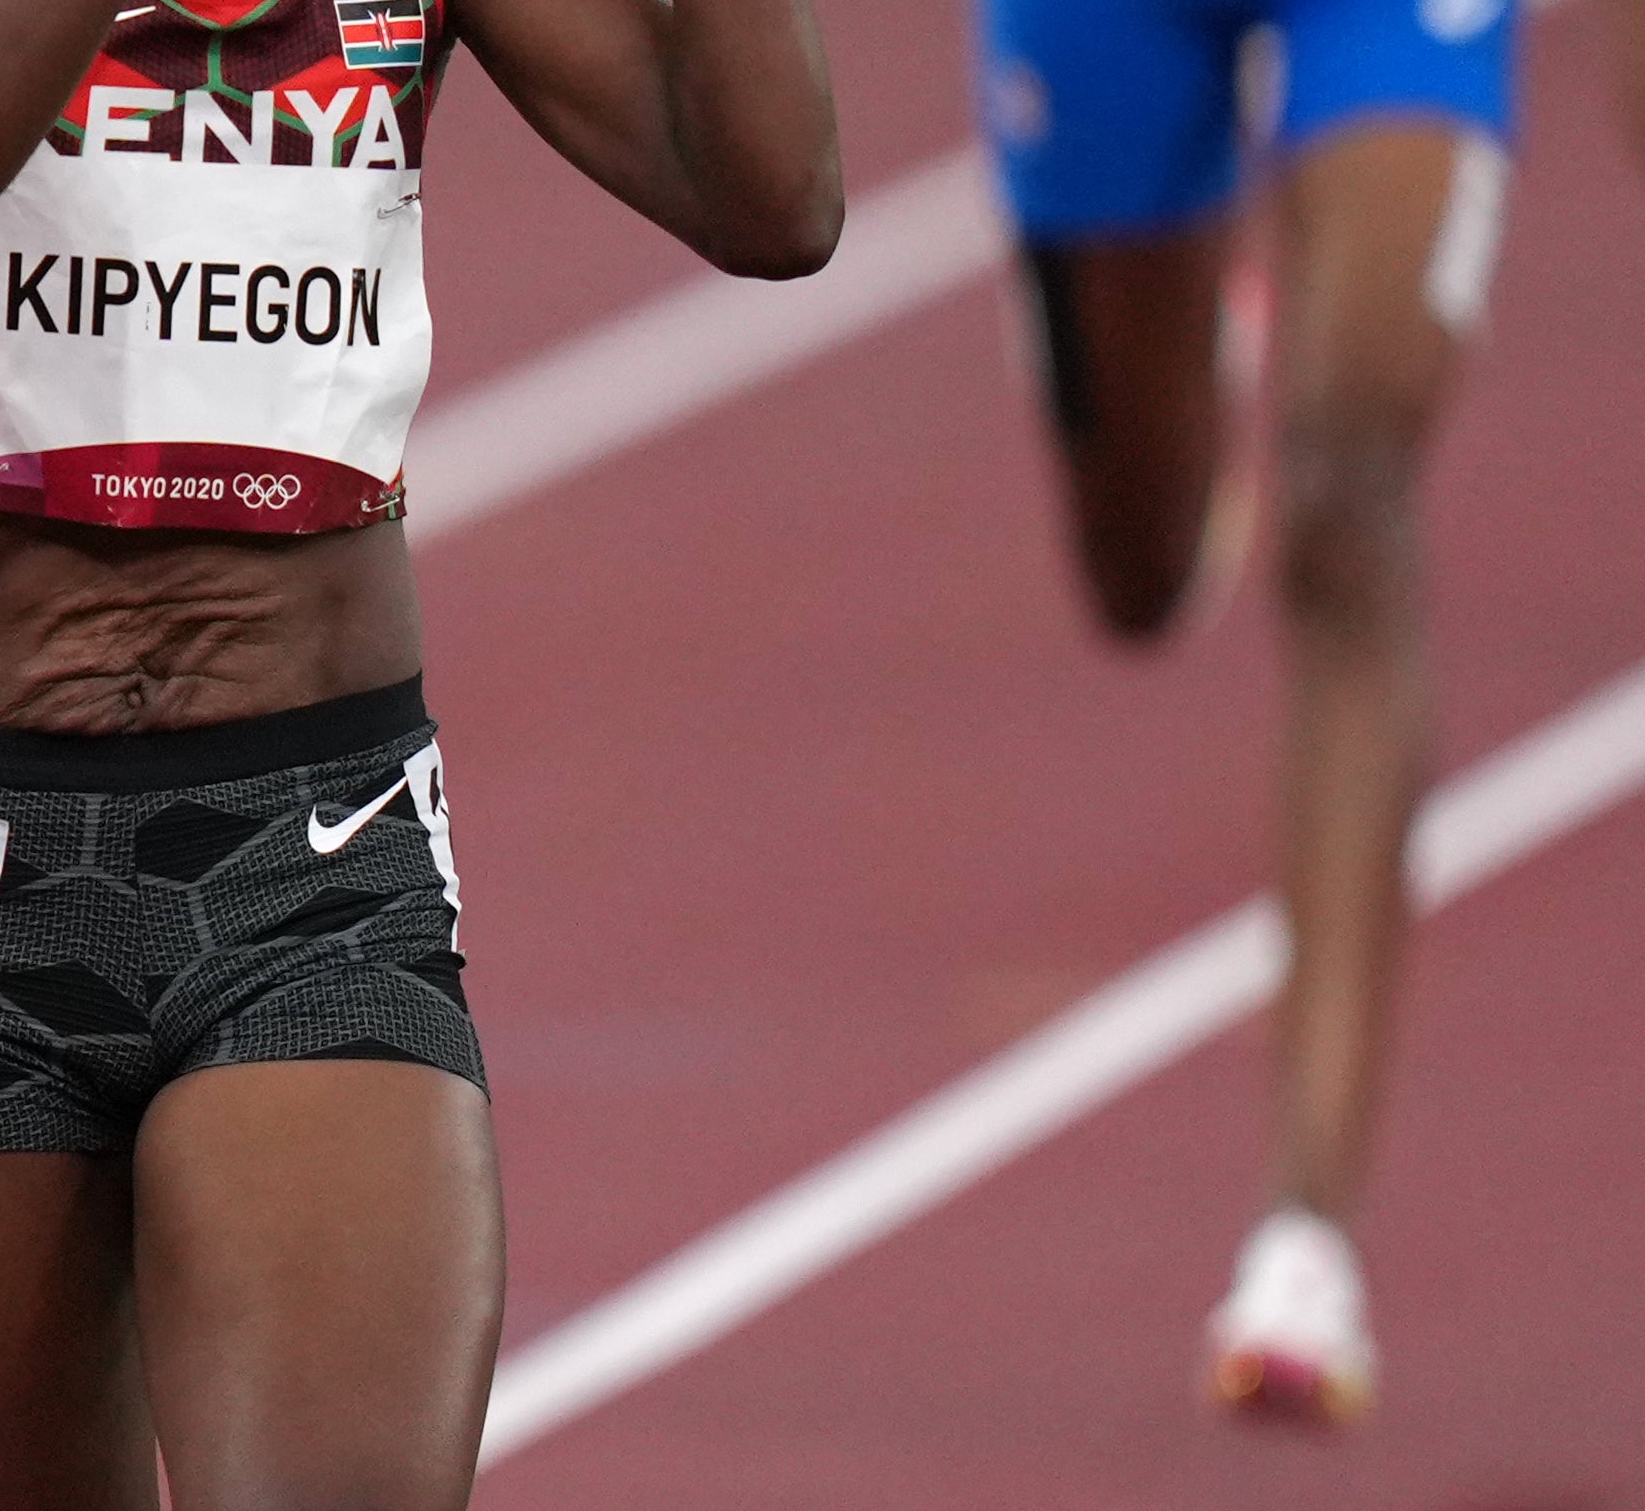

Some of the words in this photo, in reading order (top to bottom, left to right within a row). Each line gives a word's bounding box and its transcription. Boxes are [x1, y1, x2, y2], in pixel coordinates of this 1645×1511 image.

[44, 85, 406, 170] ENYA
[5, 251, 384, 347] KIPYEGON
[91, 473, 166, 497] TOKYO
[171, 476, 225, 501] 2020
